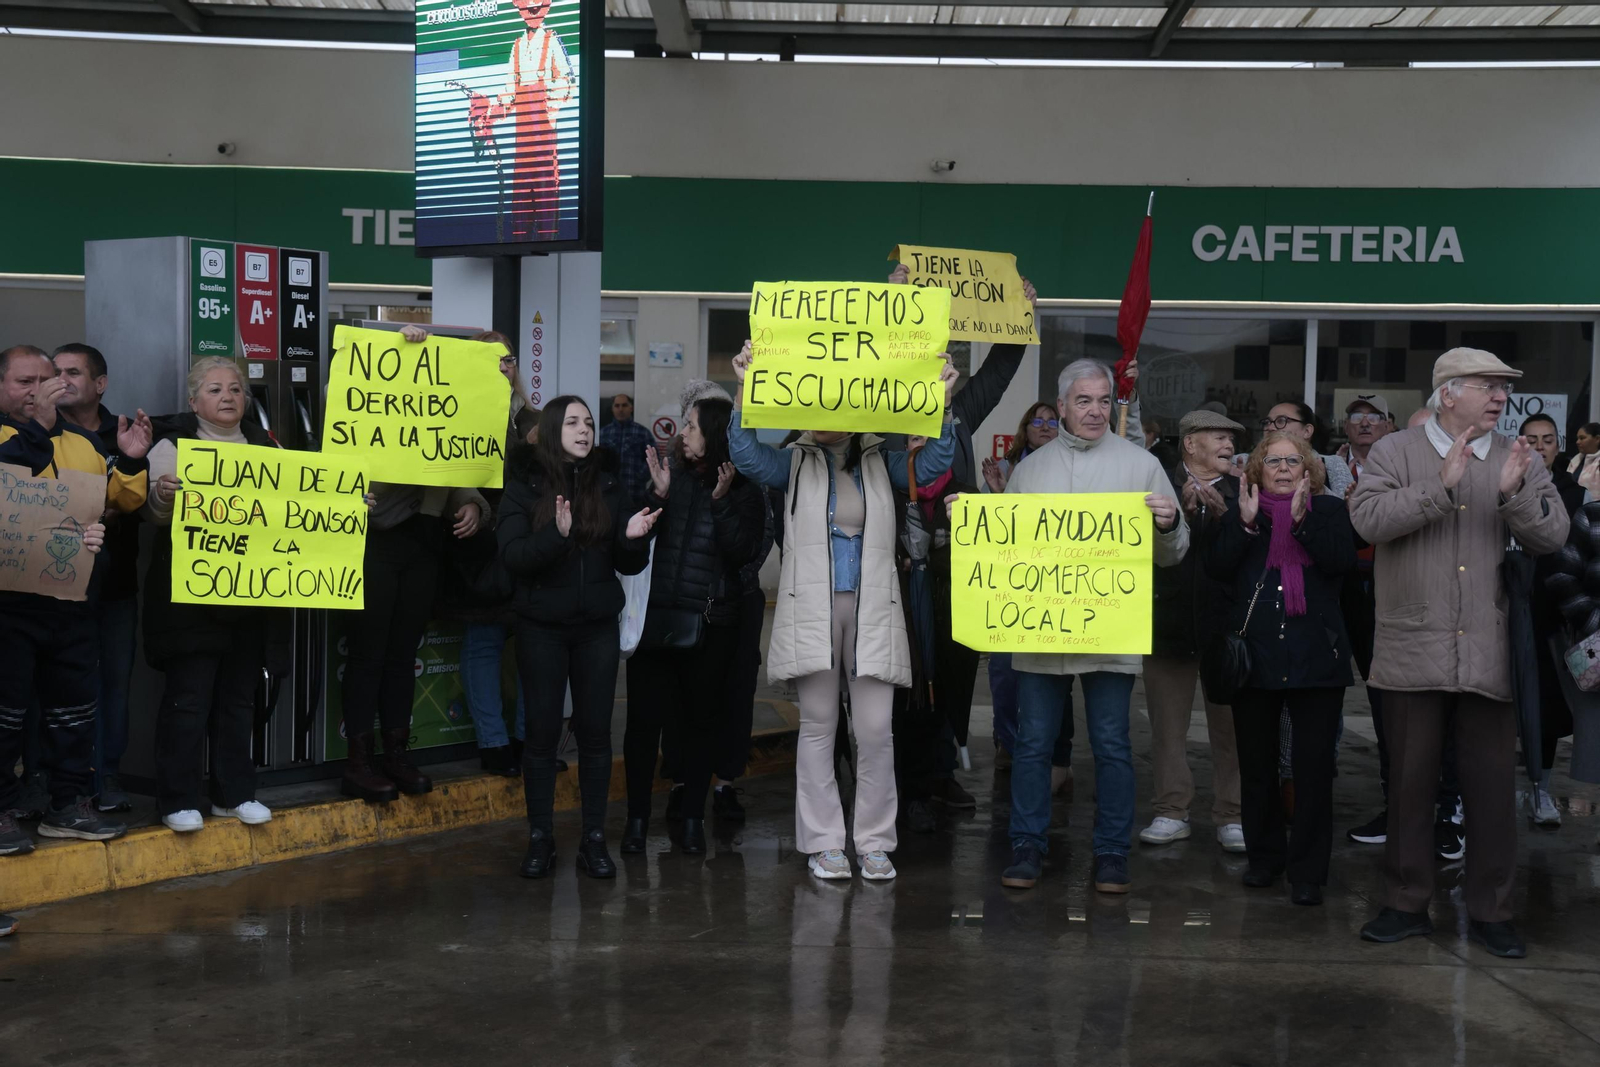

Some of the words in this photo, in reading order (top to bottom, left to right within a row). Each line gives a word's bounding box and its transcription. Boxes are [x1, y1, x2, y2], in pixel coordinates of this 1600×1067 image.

[342, 208, 415, 246] TIE
[1192, 225, 1464, 262] CAFETERIA
[208, 259, 218, 267] E5
[252, 263, 262, 271] B7
[295, 268, 305, 276] B7
[911, 253, 961, 275] TIENE
[968, 259, 984, 277] LA
[199, 283, 227, 292] Gasolina
[241, 287, 273, 297] Superdiesel
[291, 291, 310, 300] Diesel
[198, 297, 231, 319] 95+
[249, 300, 273, 325] A+
[293, 304, 316, 329] A+
[753, 288, 924, 326] MERECEMOS
[752, 327, 774, 346] 20
[888, 331, 901, 341] EN
[908, 331, 932, 341] PARO
[973, 320, 988, 333] NO
[990, 323, 1002, 334] LA
[1006, 312, 1034, 342] DAN?
[751, 346, 790, 356] FAMILIAS
[806, 330, 881, 361] SER
[887, 341, 915, 350] ANTES
[887, 350, 930, 361] NAVIDAD
[349, 342, 402, 382] NO
[413, 346, 451, 386] AL
[750, 370, 939, 416] ESCUCHADOS
[1506, 396, 1544, 417] NO
[331, 420, 359, 446] SÍ
[370, 426, 385, 448] A
[399, 426, 420, 447] LA
[184, 447, 282, 491] JUAN
[299, 466, 329, 493] DE
[335, 471, 366, 499] LA
[181, 490, 268, 527] ROSA
[285, 500, 367, 536] BONSÓN
[955, 500, 1019, 546] ¿ASÍ
[1034, 508, 1142, 547] AYUDAIS
[272, 538, 301, 555] LA
[1031, 546, 1044, 558] DE
[1055, 546, 1085, 558] 7.000
[968, 561, 997, 589] AL
[1009, 562, 1136, 597] COMERCIO
[1025, 594, 1034, 603] DE
[1044, 596, 1065, 605] 7.000
[1071, 598, 1121, 609] AFECTADOS
[1017, 635, 1026, 644] DE
[1036, 635, 1057, 644] 7.000
[1063, 636, 1101, 647] VECINOS
